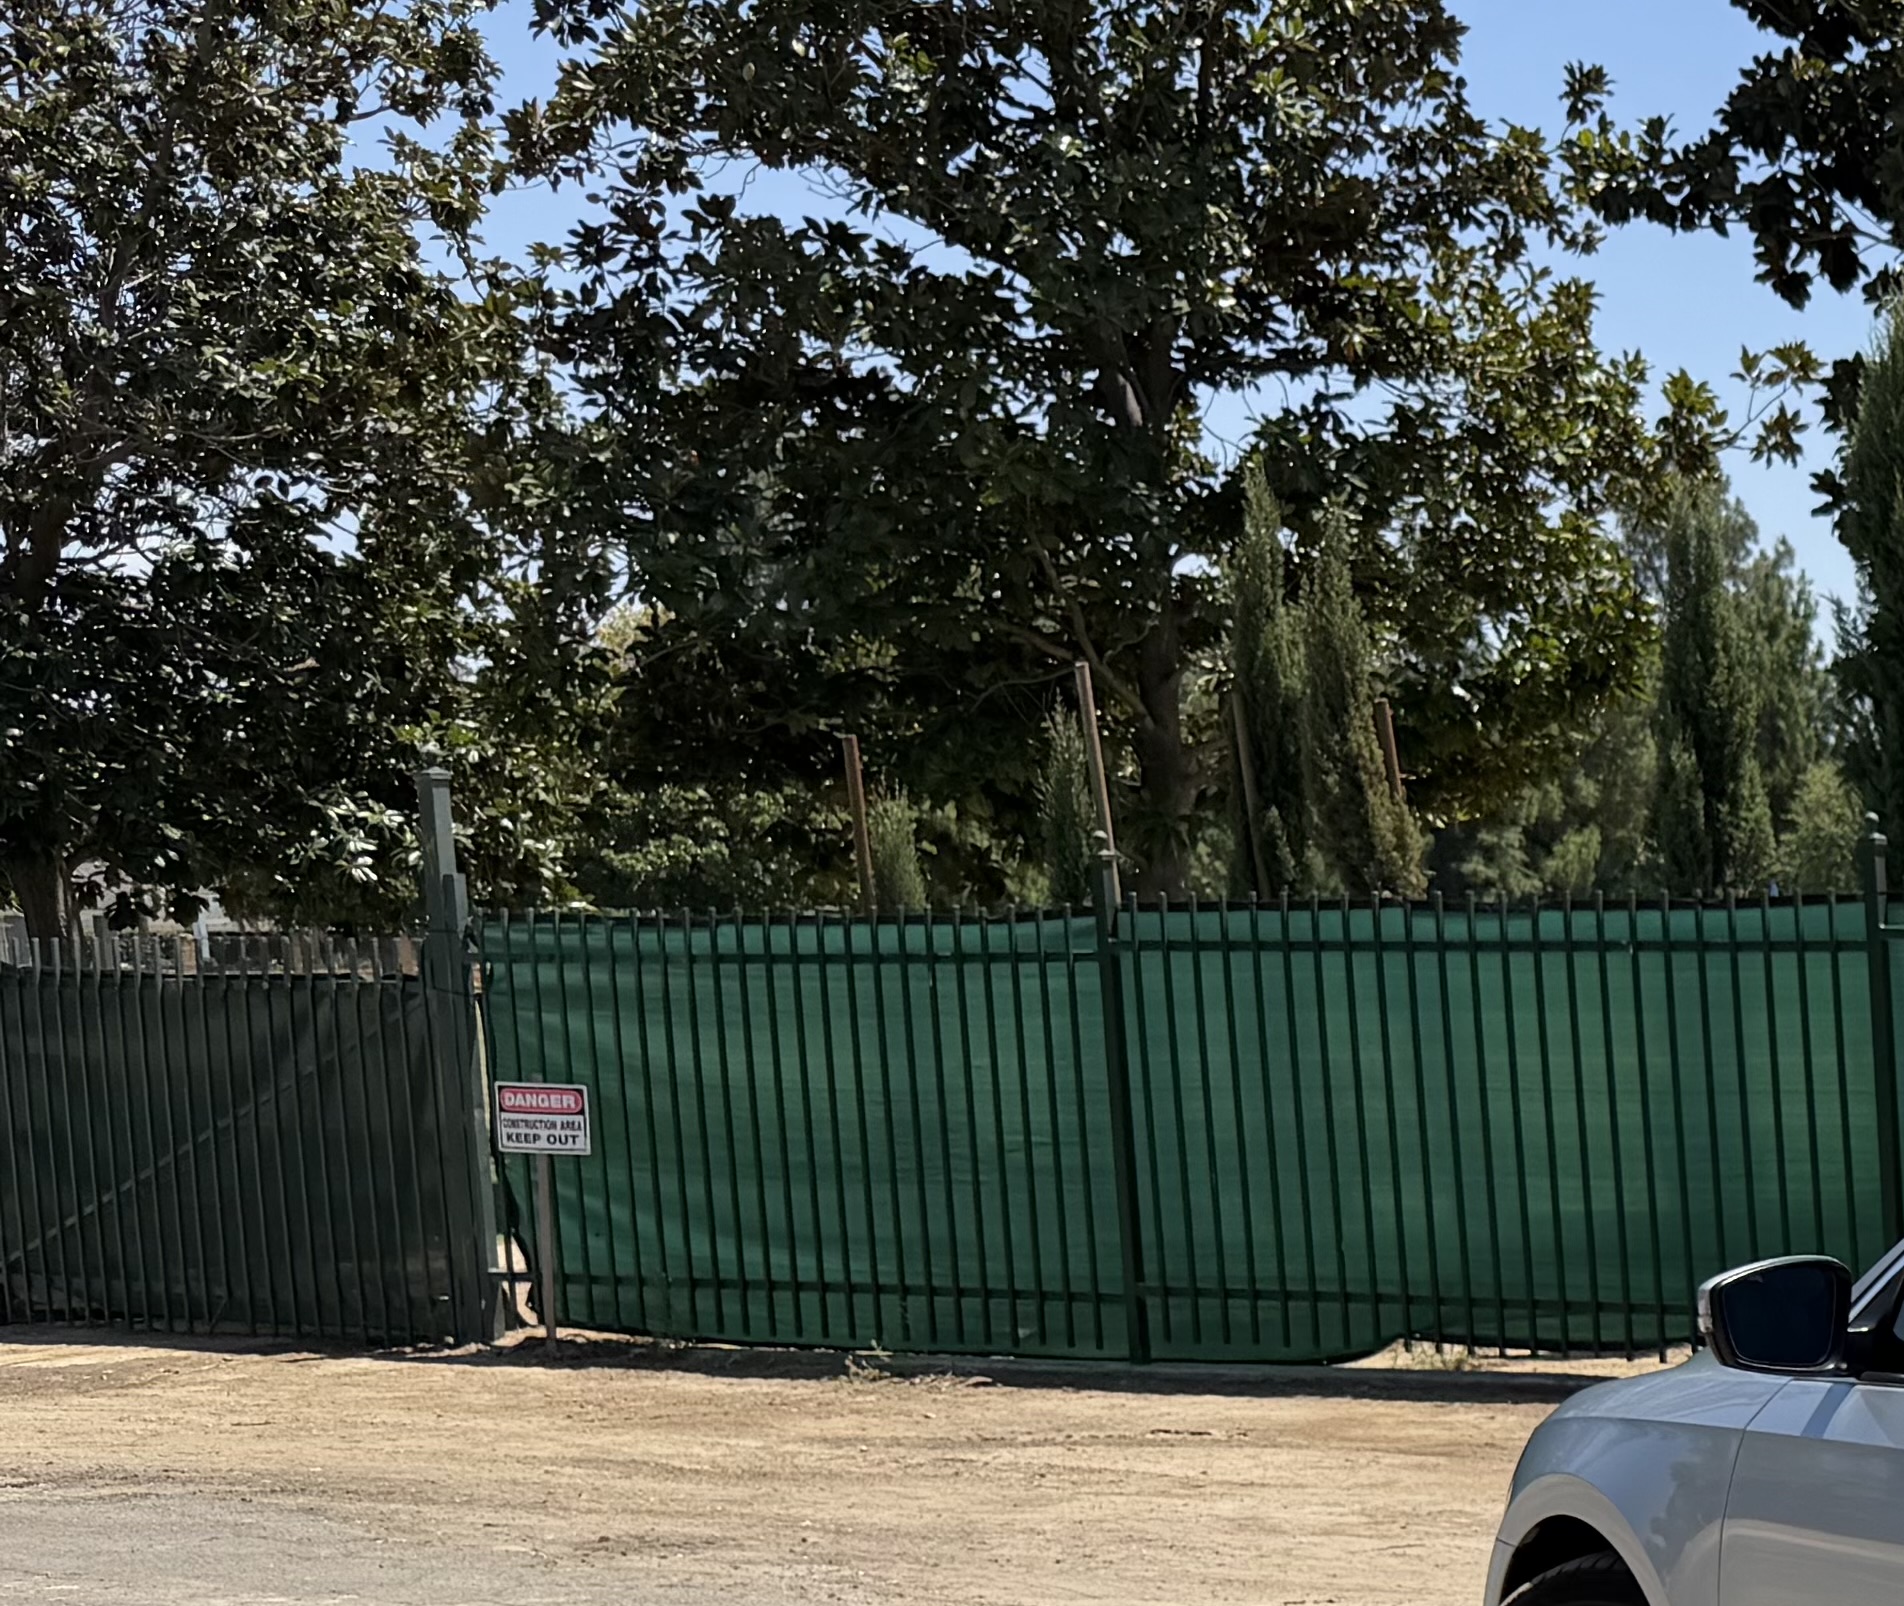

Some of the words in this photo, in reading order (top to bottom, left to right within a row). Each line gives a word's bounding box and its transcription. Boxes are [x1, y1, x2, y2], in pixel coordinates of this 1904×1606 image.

[503, 1092, 576, 1109] DANGER
[503, 1118, 558, 1131] CONSTRUCTION
[560, 1120, 582, 1131] AREA
[506, 1132, 541, 1144] KEEP
[546, 1134, 579, 1146] OUT
